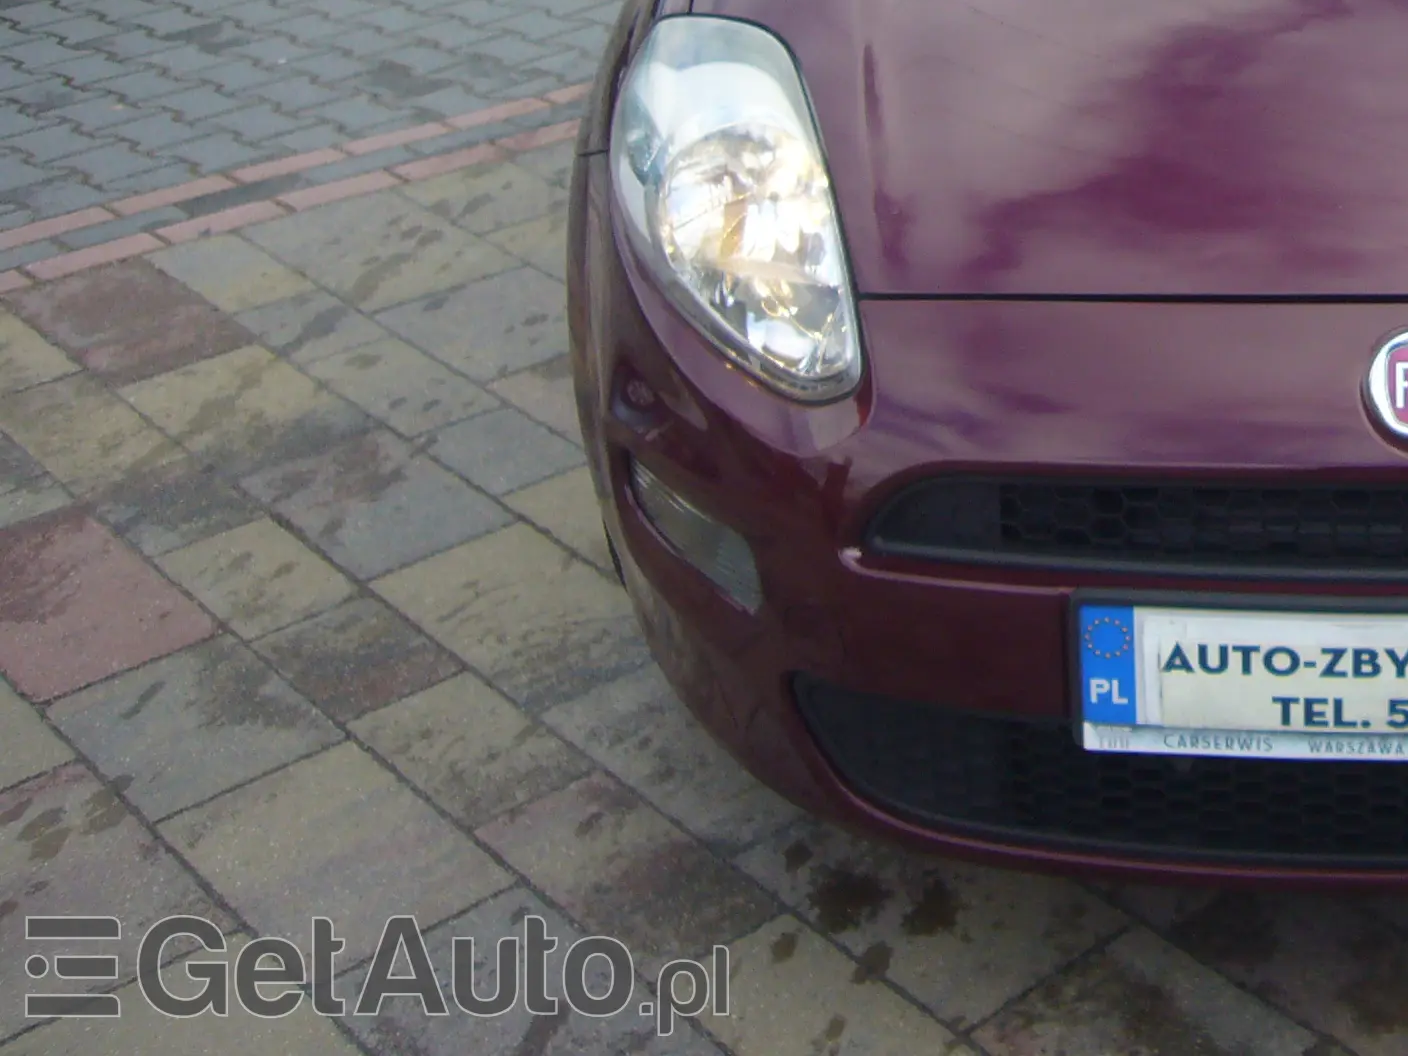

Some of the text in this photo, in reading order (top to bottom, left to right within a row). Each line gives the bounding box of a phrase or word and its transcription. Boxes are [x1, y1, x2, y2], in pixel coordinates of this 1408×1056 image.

[1089, 678, 1128, 704] PL
[1272, 696, 1372, 728] TEL.
[1163, 732, 1274, 752] CARSERWIS
[1308, 736, 1405, 755] WARSZAWA
